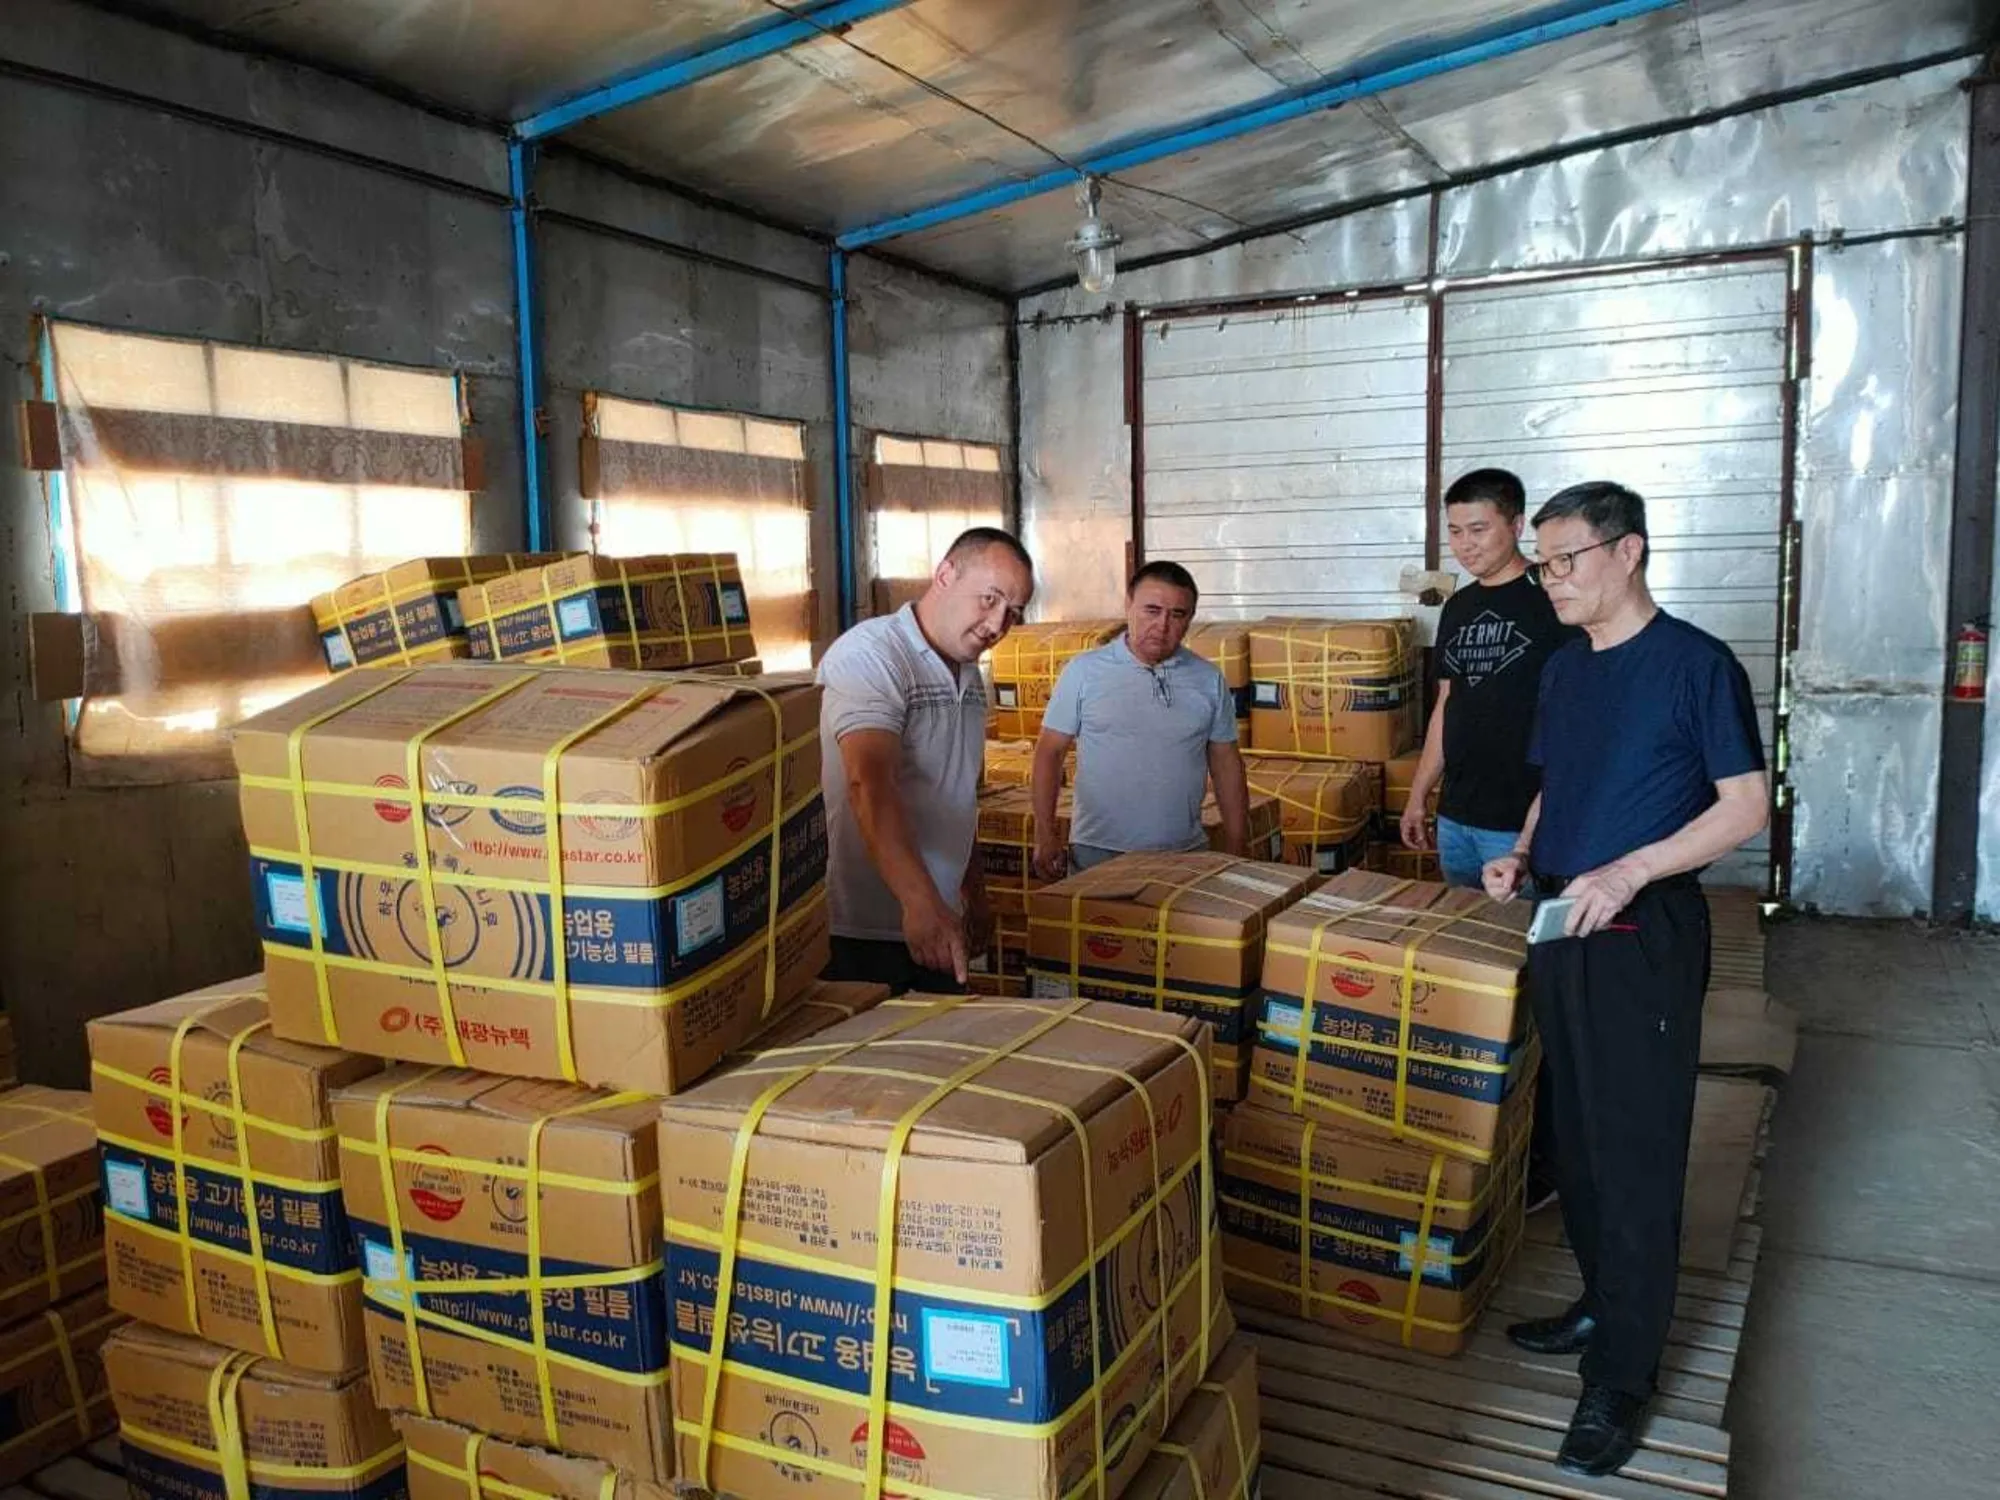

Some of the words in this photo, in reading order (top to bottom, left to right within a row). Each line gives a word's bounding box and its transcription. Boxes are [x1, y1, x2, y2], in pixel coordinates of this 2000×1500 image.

[1457, 621, 1515, 646] TERMIT
[567, 941, 617, 964] 기능성
[623, 941, 654, 964] 필름
[204, 1182, 276, 1221] 고기성
[281, 1198, 322, 1230] 필름
[728, 1312, 826, 1362] 고기능성
